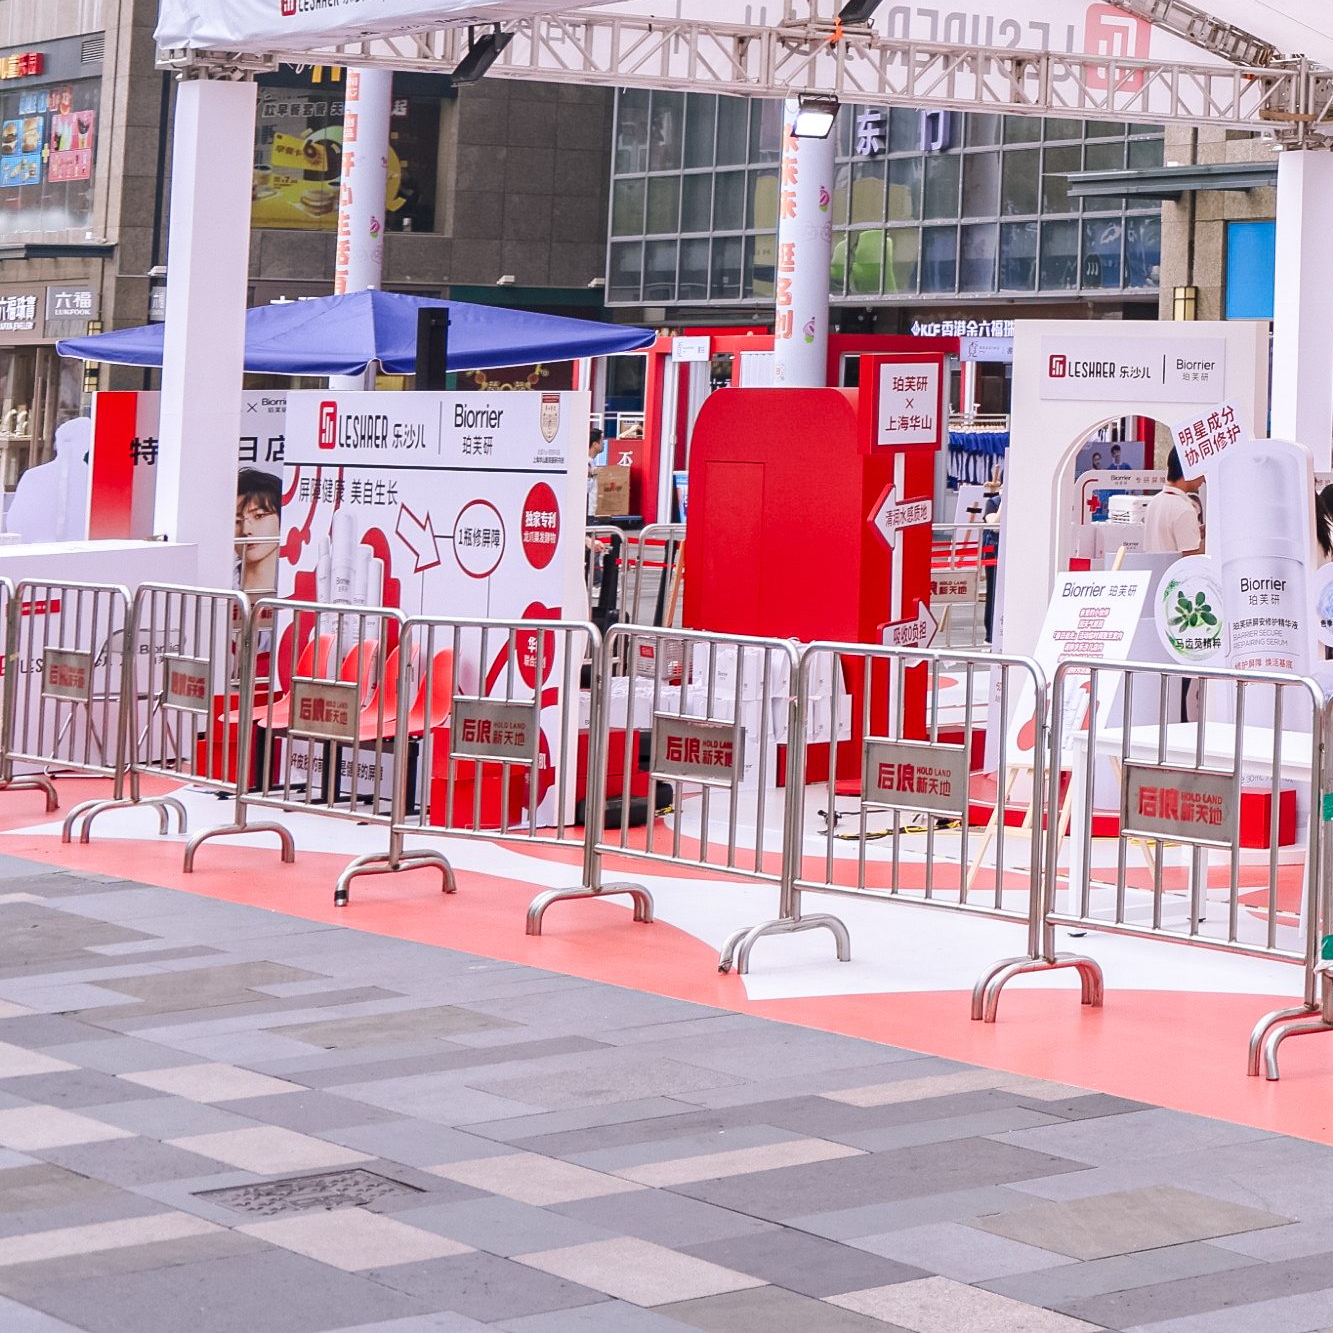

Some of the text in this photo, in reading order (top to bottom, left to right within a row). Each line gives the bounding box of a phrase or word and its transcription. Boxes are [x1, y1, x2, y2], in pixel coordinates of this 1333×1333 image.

[54, 292, 92, 308] 六福
[1119, 366, 1152, 379] 乐沙儿
[1176, 358, 1215, 372] Biorrier
[892, 375, 928, 392] 珀芙研
[1182, 372, 1209, 382] 珀芙研
[454, 404, 504, 429] Biorrier
[885, 415, 932, 432] 上海华山
[1178, 405, 1235, 447] 明星成分
[391, 422, 426, 450] 乐沙儿
[1185, 423, 1242, 466] 协同修护
[462, 436, 494, 456] 珀芙研
[299, 477, 398, 506] 屏障健康 美自生长
[458, 529, 501, 549] 1瓶修屏障
[1062, 582, 1105, 598] Biorrier
[1108, 584, 1137, 598] 珀芙研
[1240, 577, 1287, 593] Biorrier
[1249, 594, 1281, 606] 珀芙研
[493, 729, 526, 748] 新天地
[665, 734, 700, 766] 后浪
[702, 750, 733, 768] 新天地
[877, 762, 915, 793] 后浪
[917, 766, 951, 778] HOLD LAND
[917, 776, 951, 797] 新天地
[1181, 800, 1222, 826] 新天地
